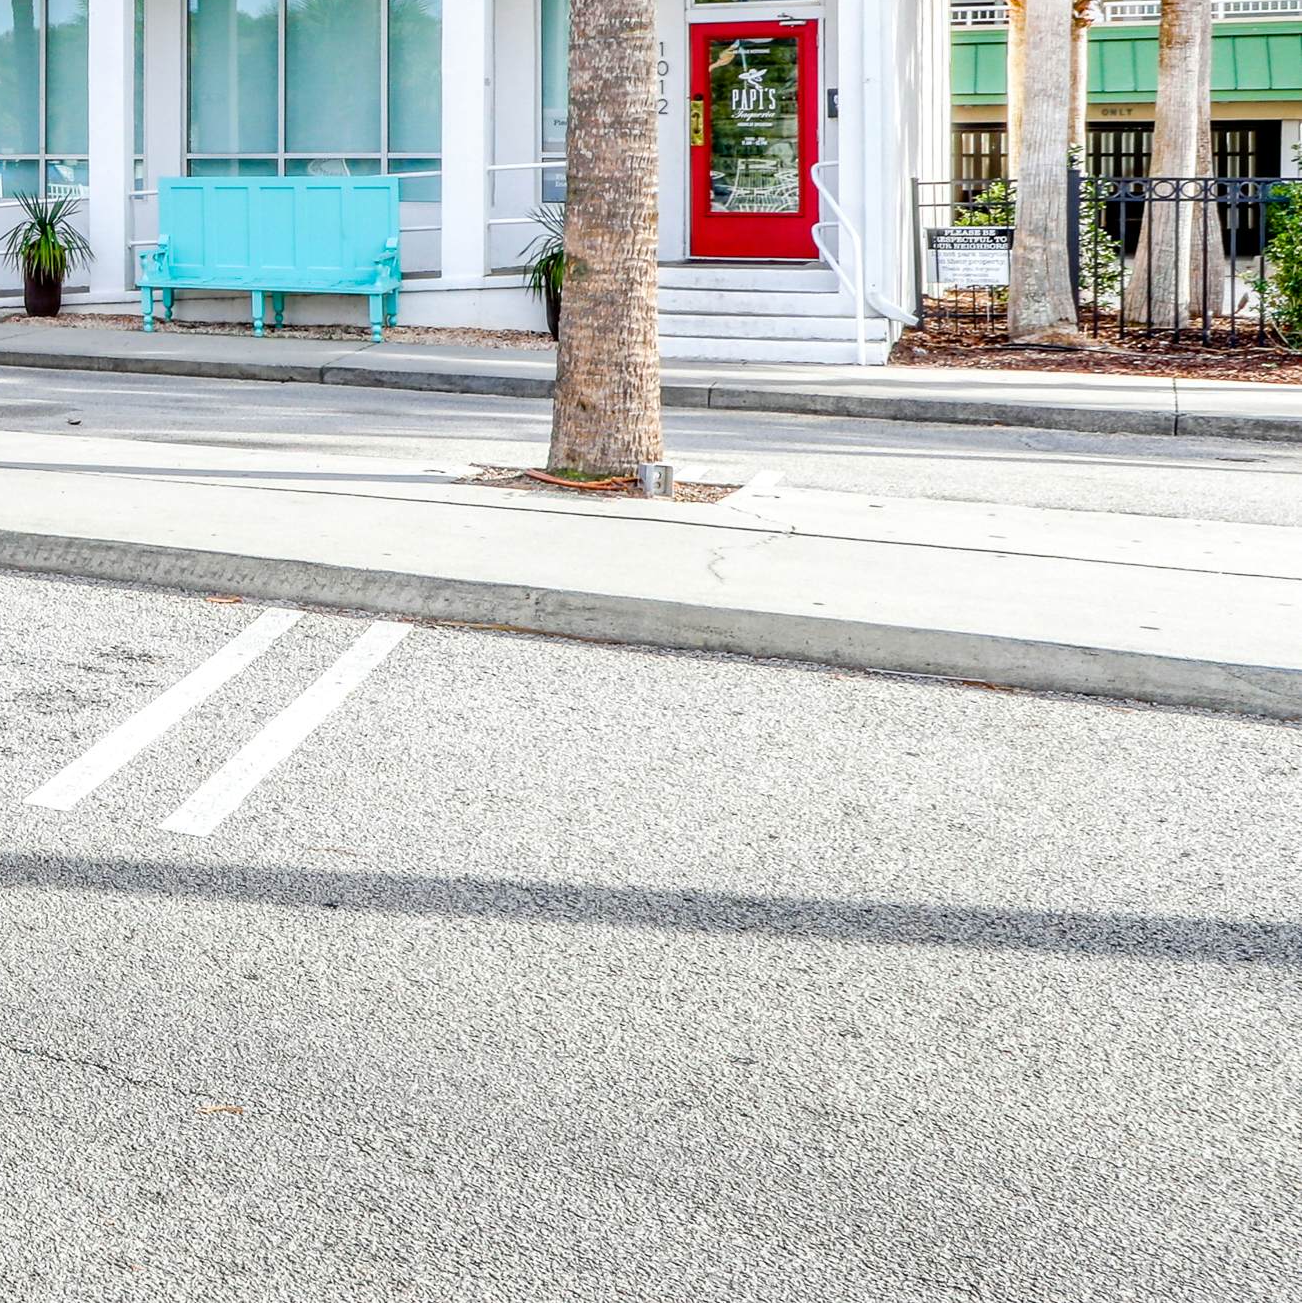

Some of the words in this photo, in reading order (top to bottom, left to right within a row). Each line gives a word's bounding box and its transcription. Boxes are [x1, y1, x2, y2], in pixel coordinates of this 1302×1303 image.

[657, 41, 670, 115] 1012
[731, 88, 776, 110] PAPI'S
[1101, 108, 1133, 116] ONLY
